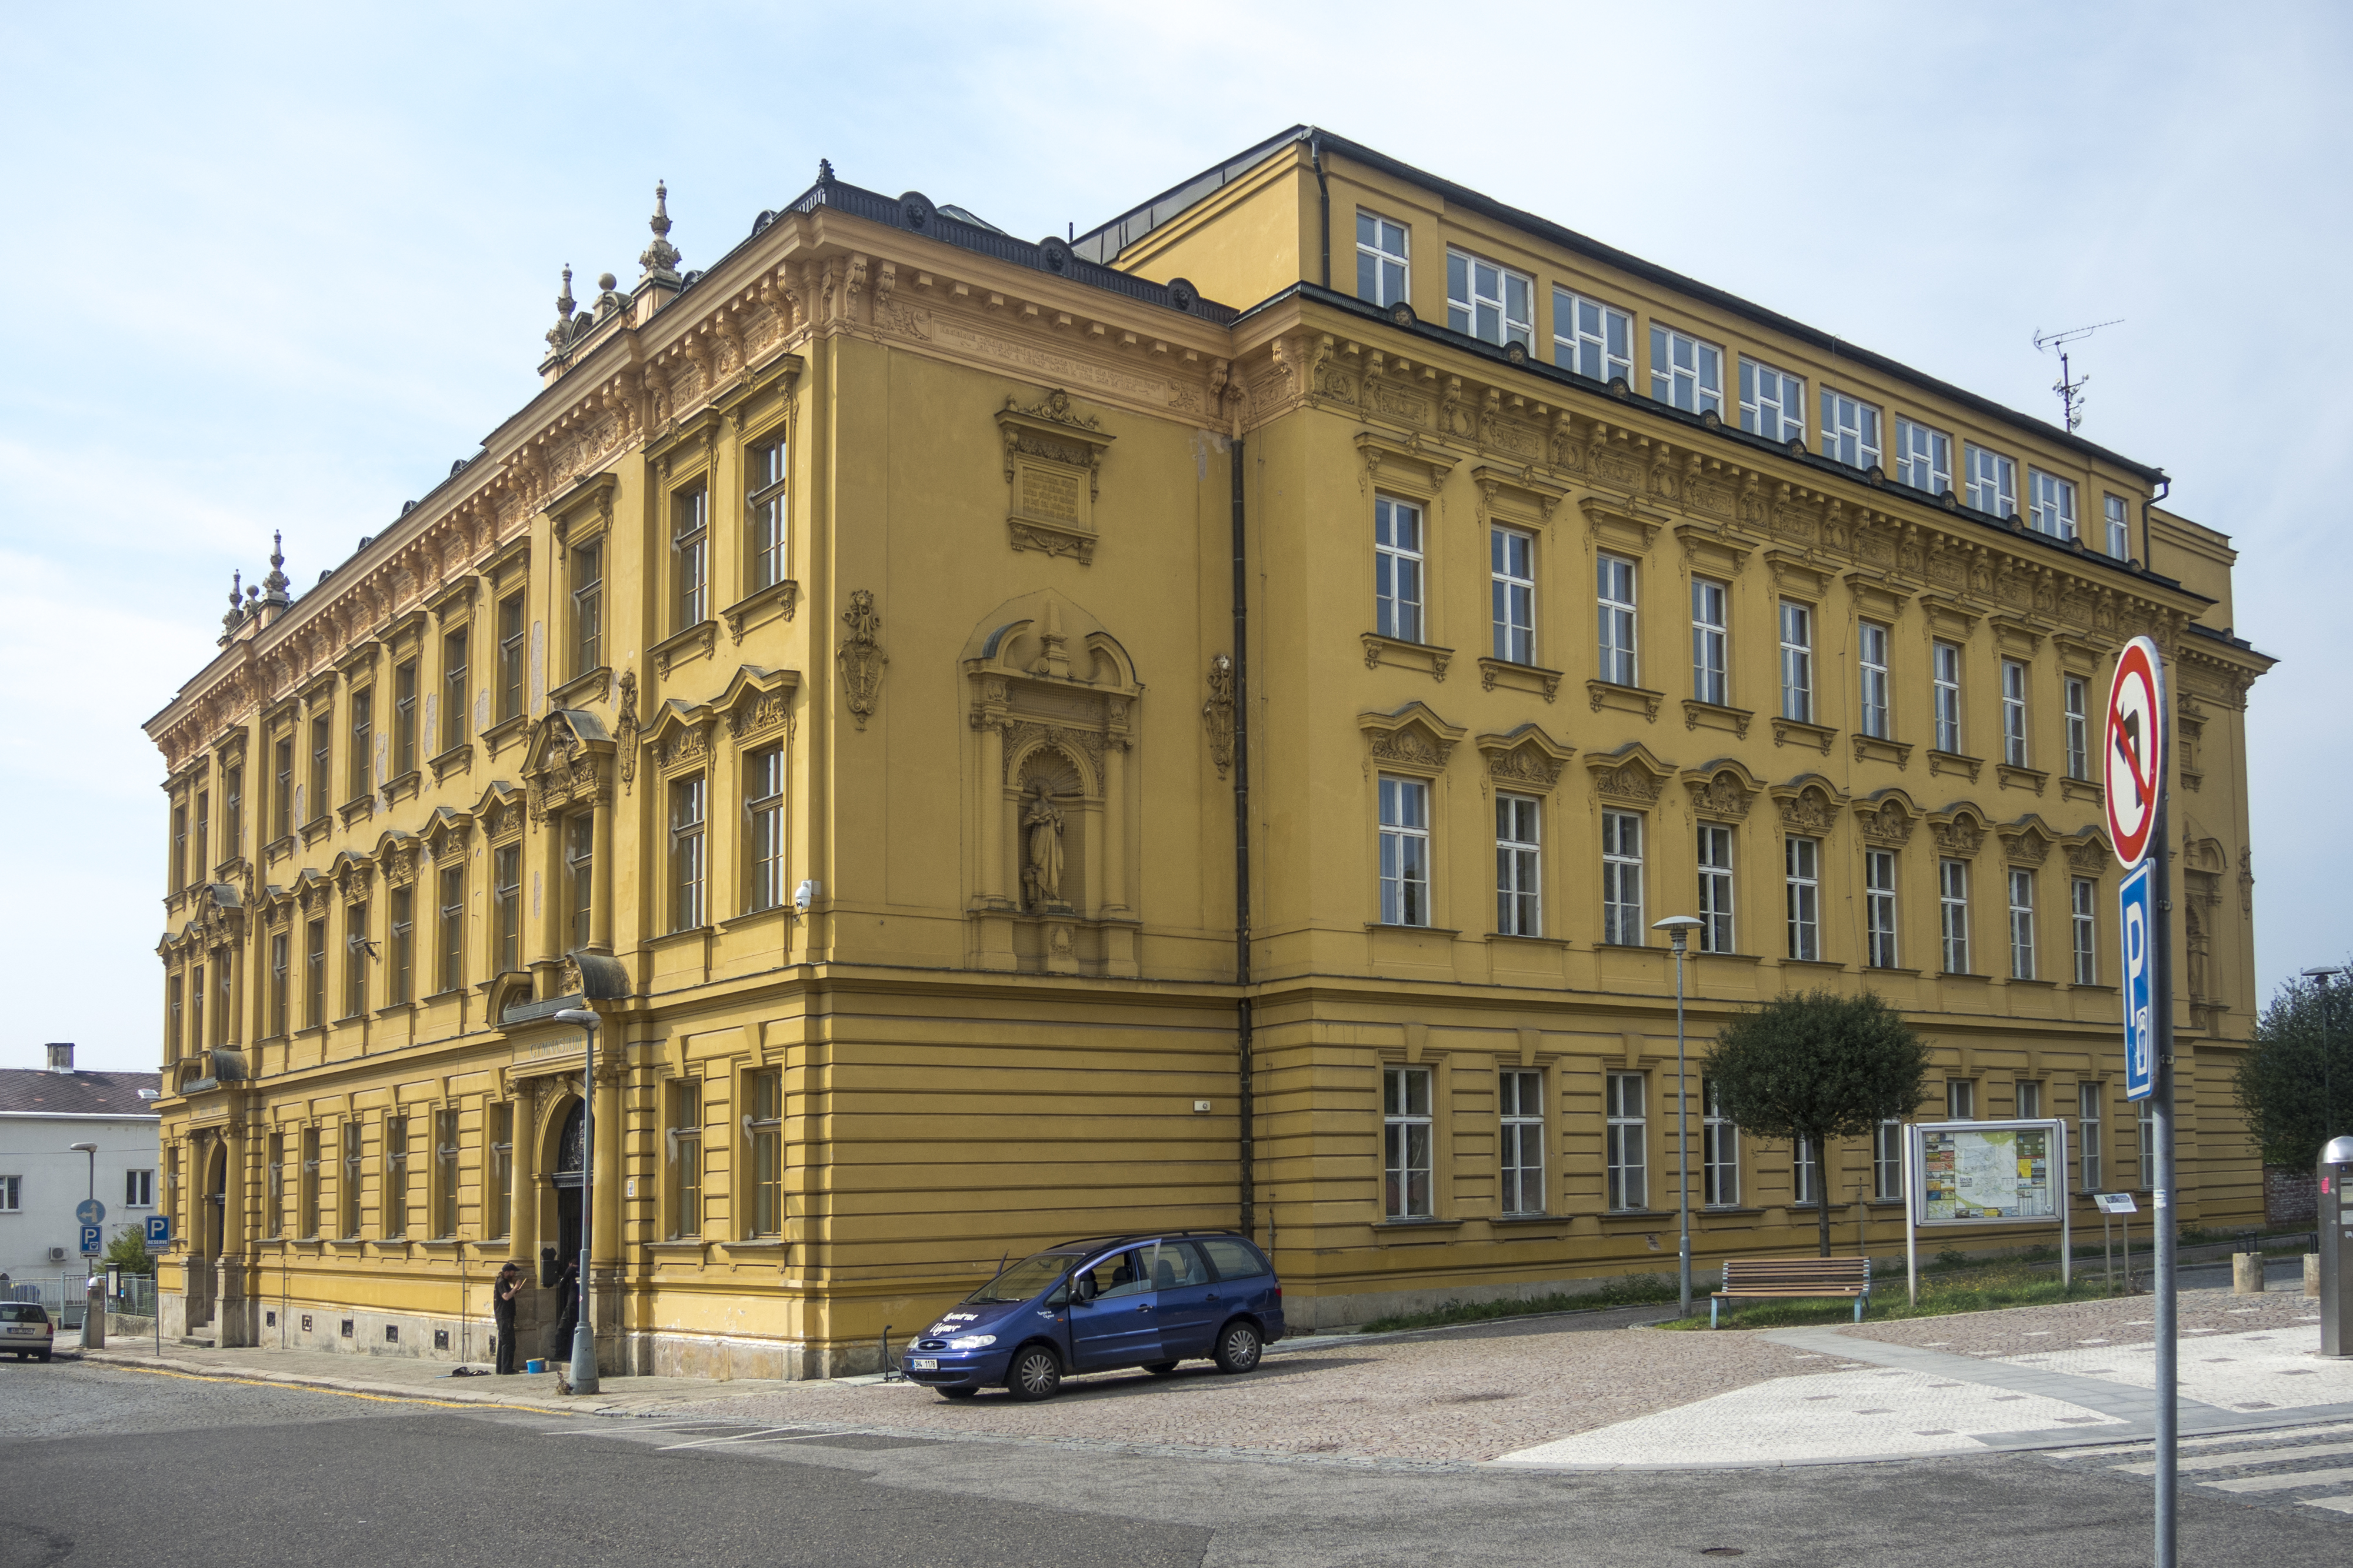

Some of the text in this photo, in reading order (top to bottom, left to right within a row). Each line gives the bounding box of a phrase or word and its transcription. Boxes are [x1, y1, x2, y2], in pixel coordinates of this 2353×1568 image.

[2126, 901, 2144, 1027] P
[530, 1035, 582, 1058] GYMNASIUM
[85, 1229, 97, 1244] P
[151, 1220, 165, 1237] P
